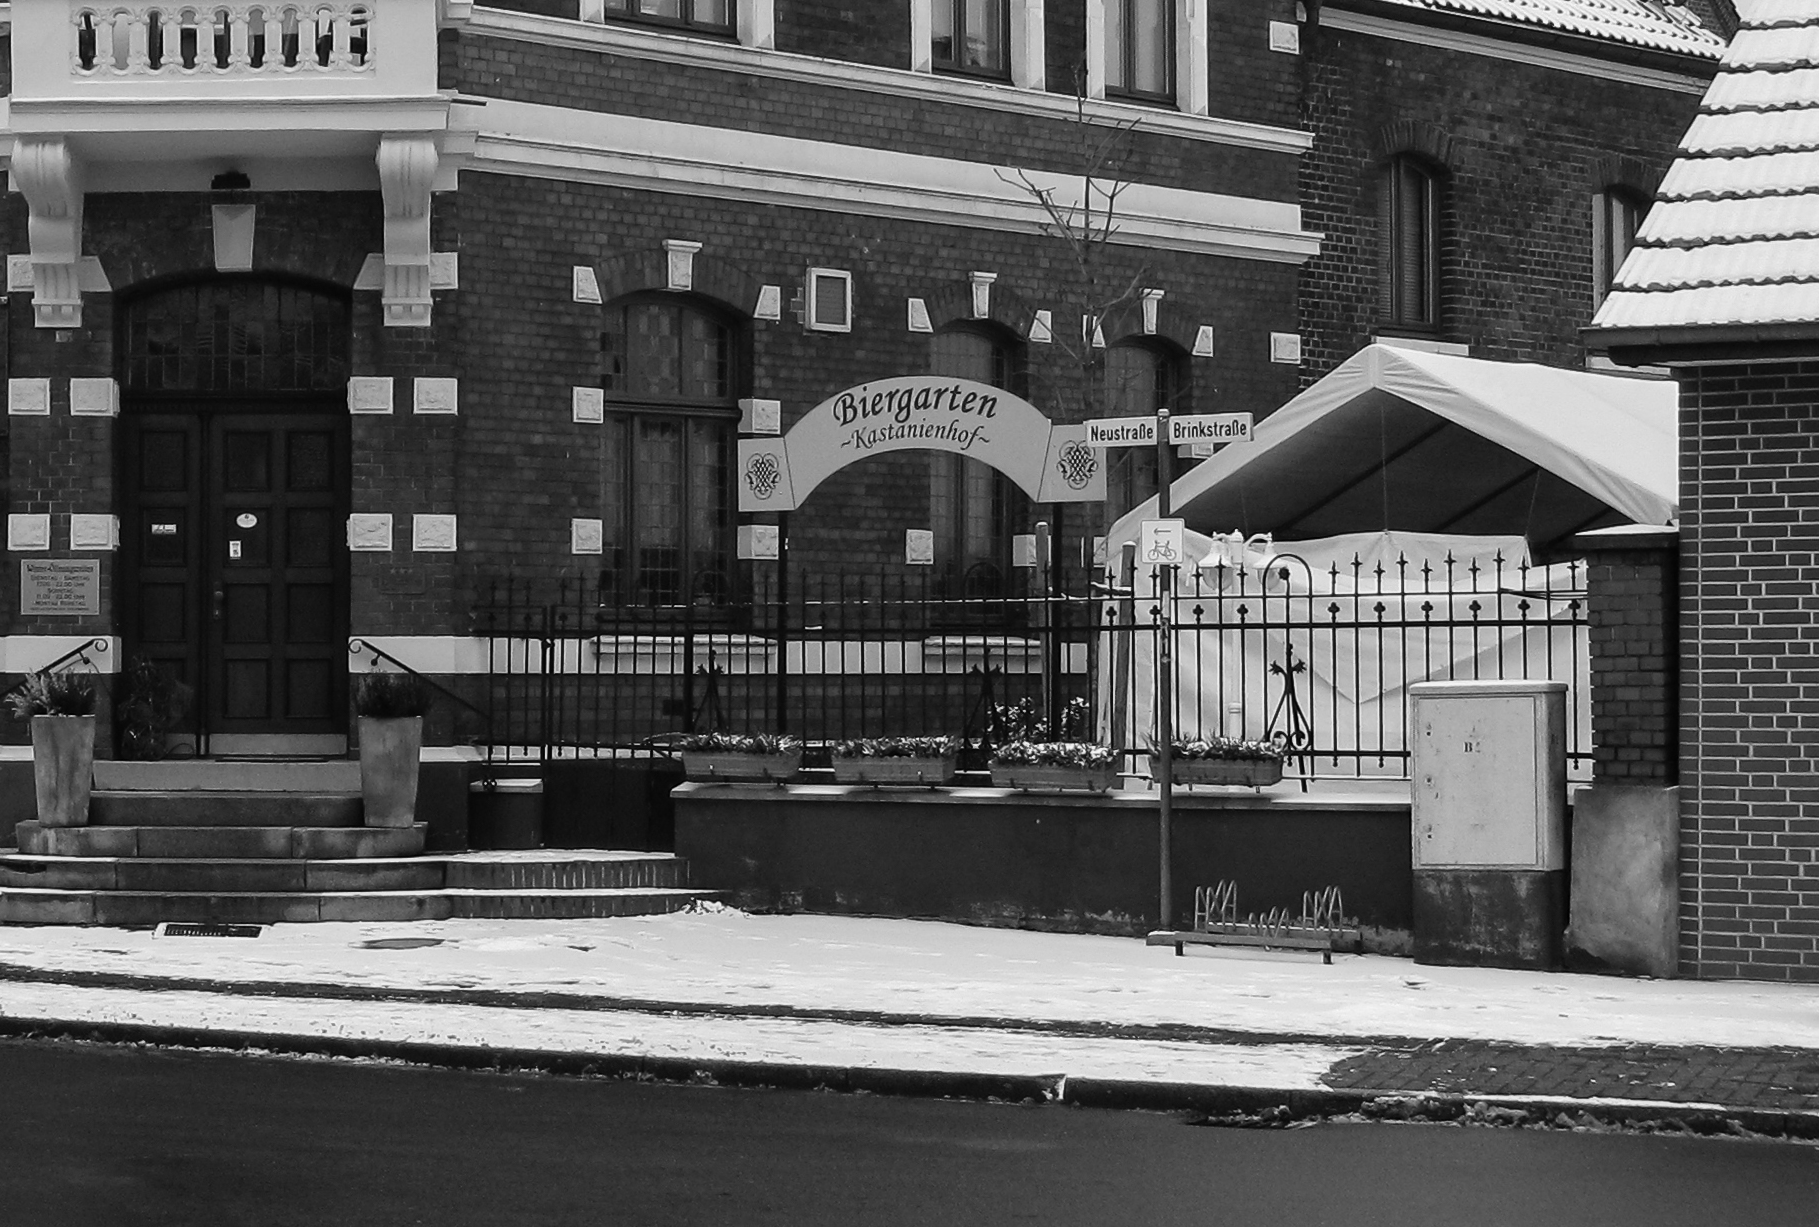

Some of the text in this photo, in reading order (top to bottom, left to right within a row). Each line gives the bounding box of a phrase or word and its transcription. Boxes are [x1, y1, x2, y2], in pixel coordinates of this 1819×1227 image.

[833, 384, 998, 427] Biergarten
[1090, 424, 1154, 442] Neustraße
[1174, 420, 1247, 439] Brinkstraße
